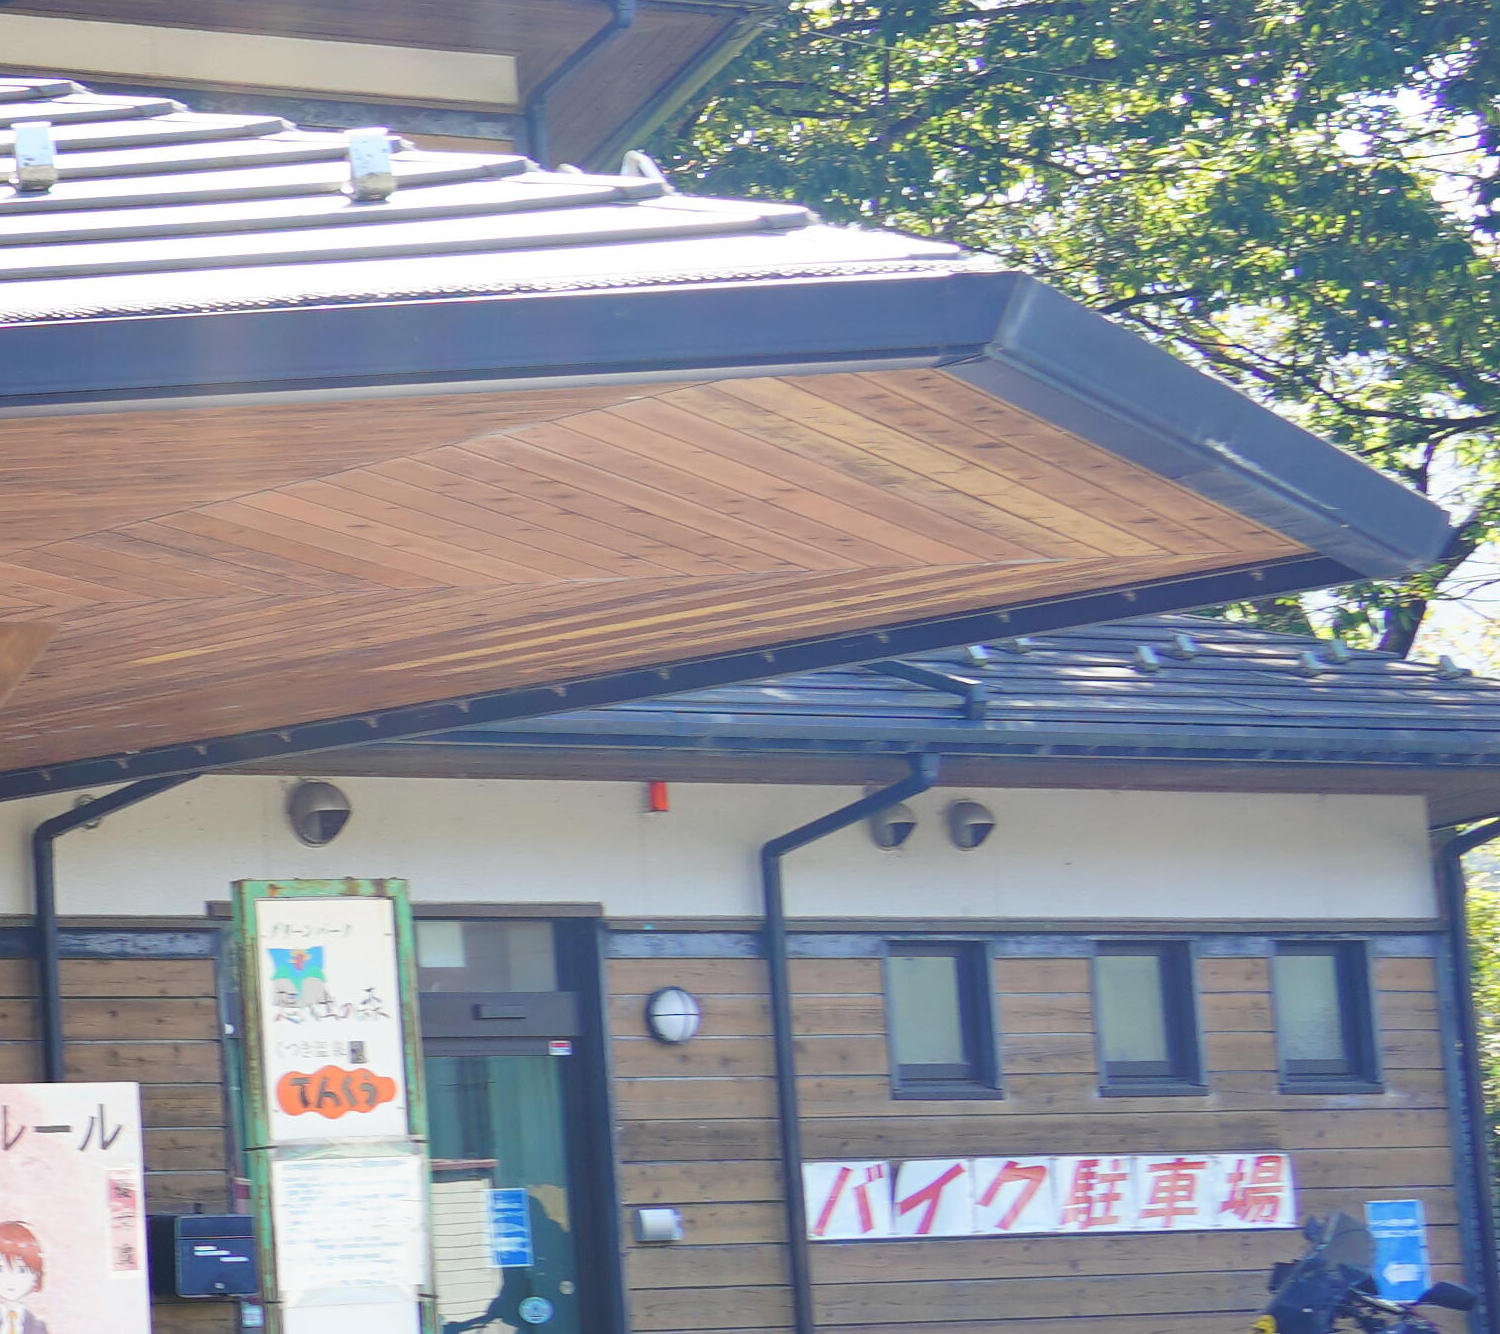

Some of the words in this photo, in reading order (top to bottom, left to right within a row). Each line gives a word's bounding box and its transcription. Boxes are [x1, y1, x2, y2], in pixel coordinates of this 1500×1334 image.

[289, 1072, 379, 1110] てんくう
[808, 1153, 1285, 1237] バイク駐車場
